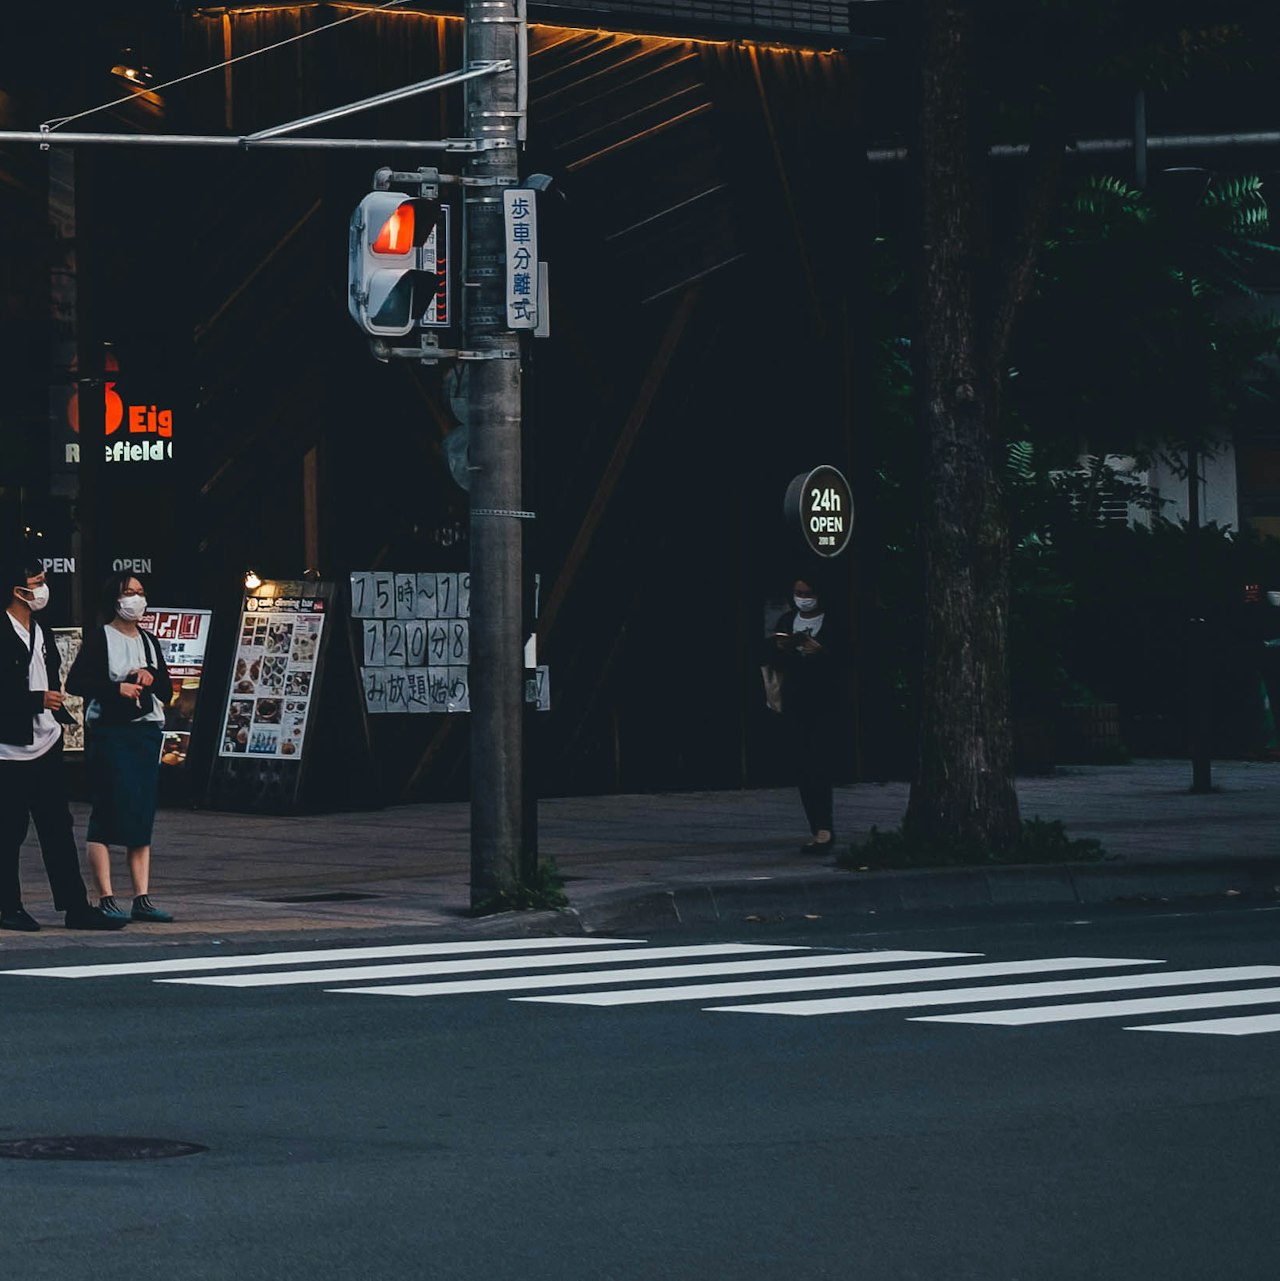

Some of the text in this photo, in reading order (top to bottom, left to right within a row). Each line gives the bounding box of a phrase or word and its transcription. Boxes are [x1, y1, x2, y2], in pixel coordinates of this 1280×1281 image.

[511, 198, 533, 321] 歩車分離式
[811, 488, 842, 512] 24h
[810, 516, 843, 533] OPEN
[37, 558, 76, 573] PEN
[112, 558, 152, 573] OPEN
